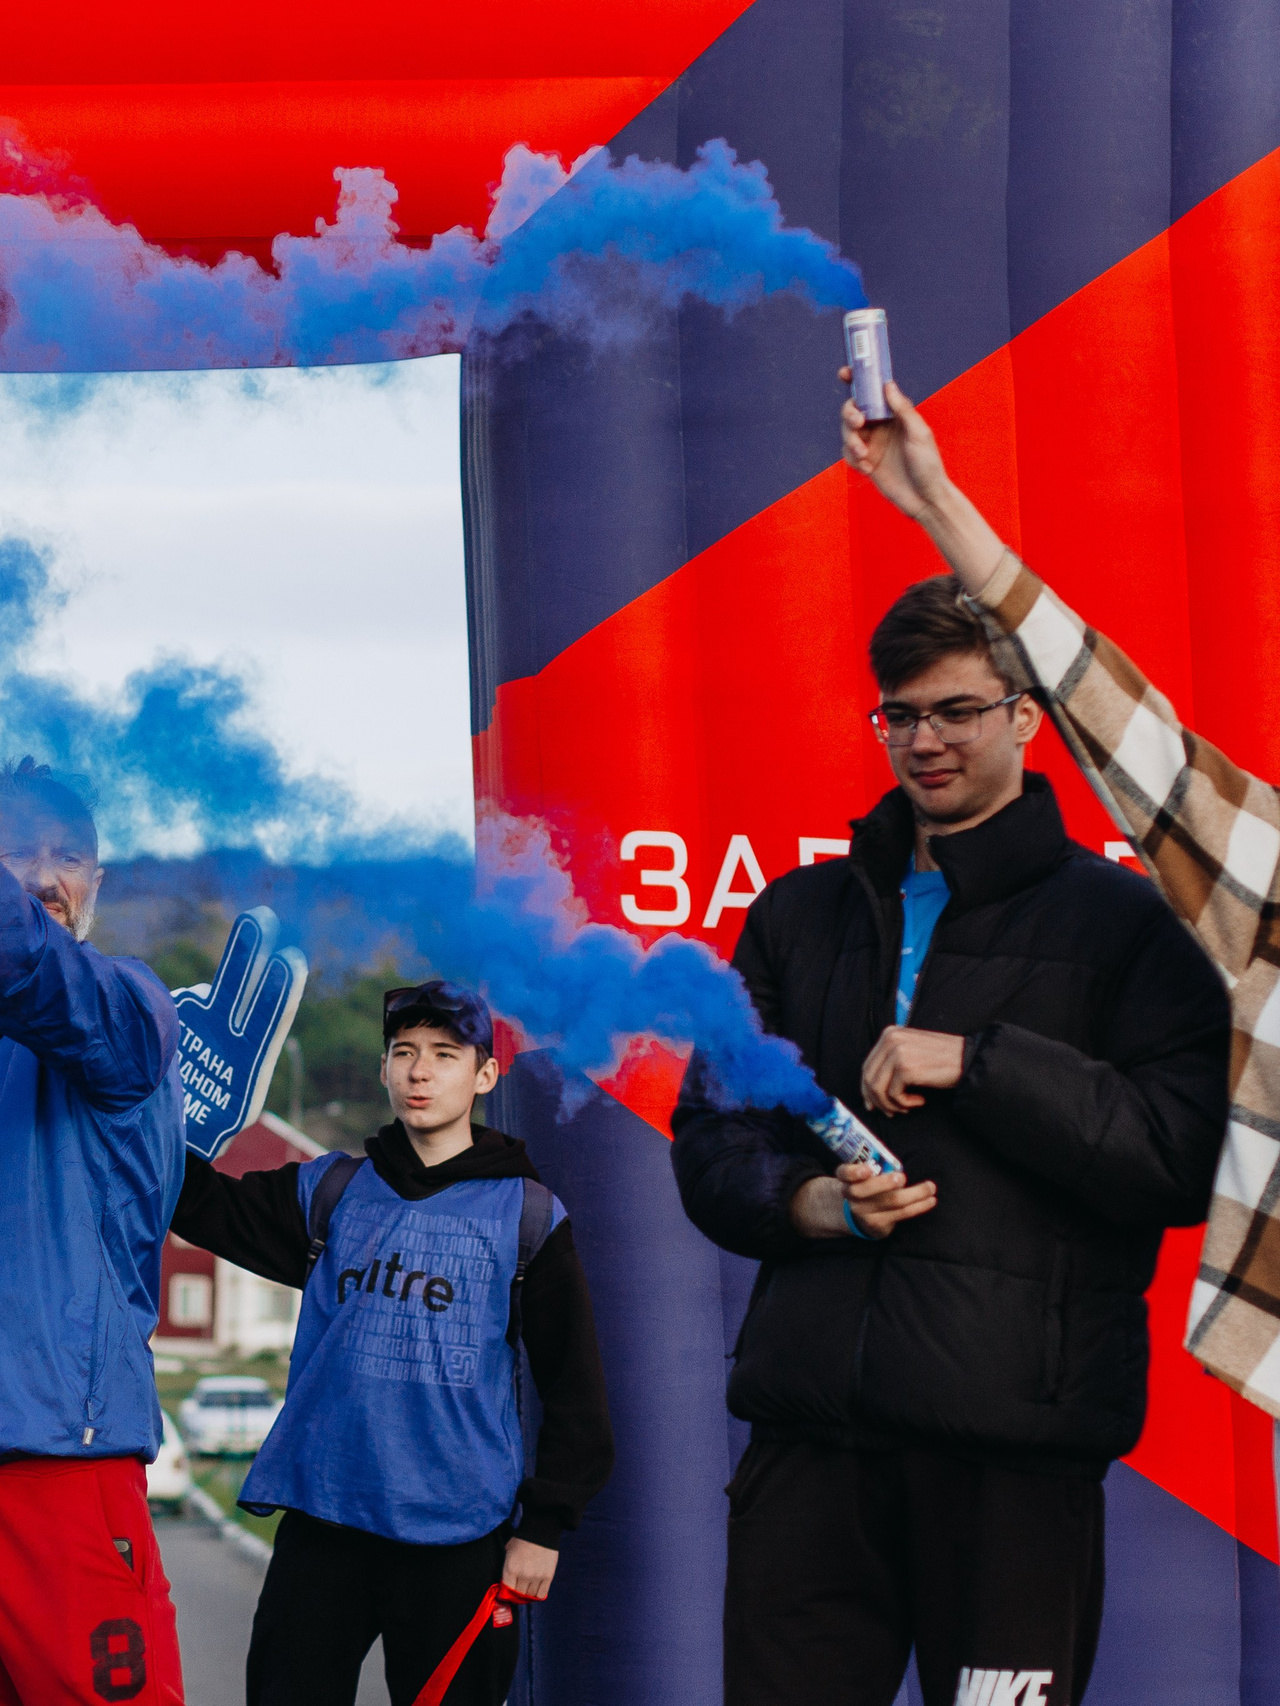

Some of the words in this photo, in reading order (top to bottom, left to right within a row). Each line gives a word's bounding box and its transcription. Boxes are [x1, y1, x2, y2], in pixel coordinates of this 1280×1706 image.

[177, 1049, 232, 1112] ДНОМ
[181, 1087, 213, 1126] МЕ
[89, 1617, 147, 1703] 8
[953, 1666, 1054, 1706] NIKE
